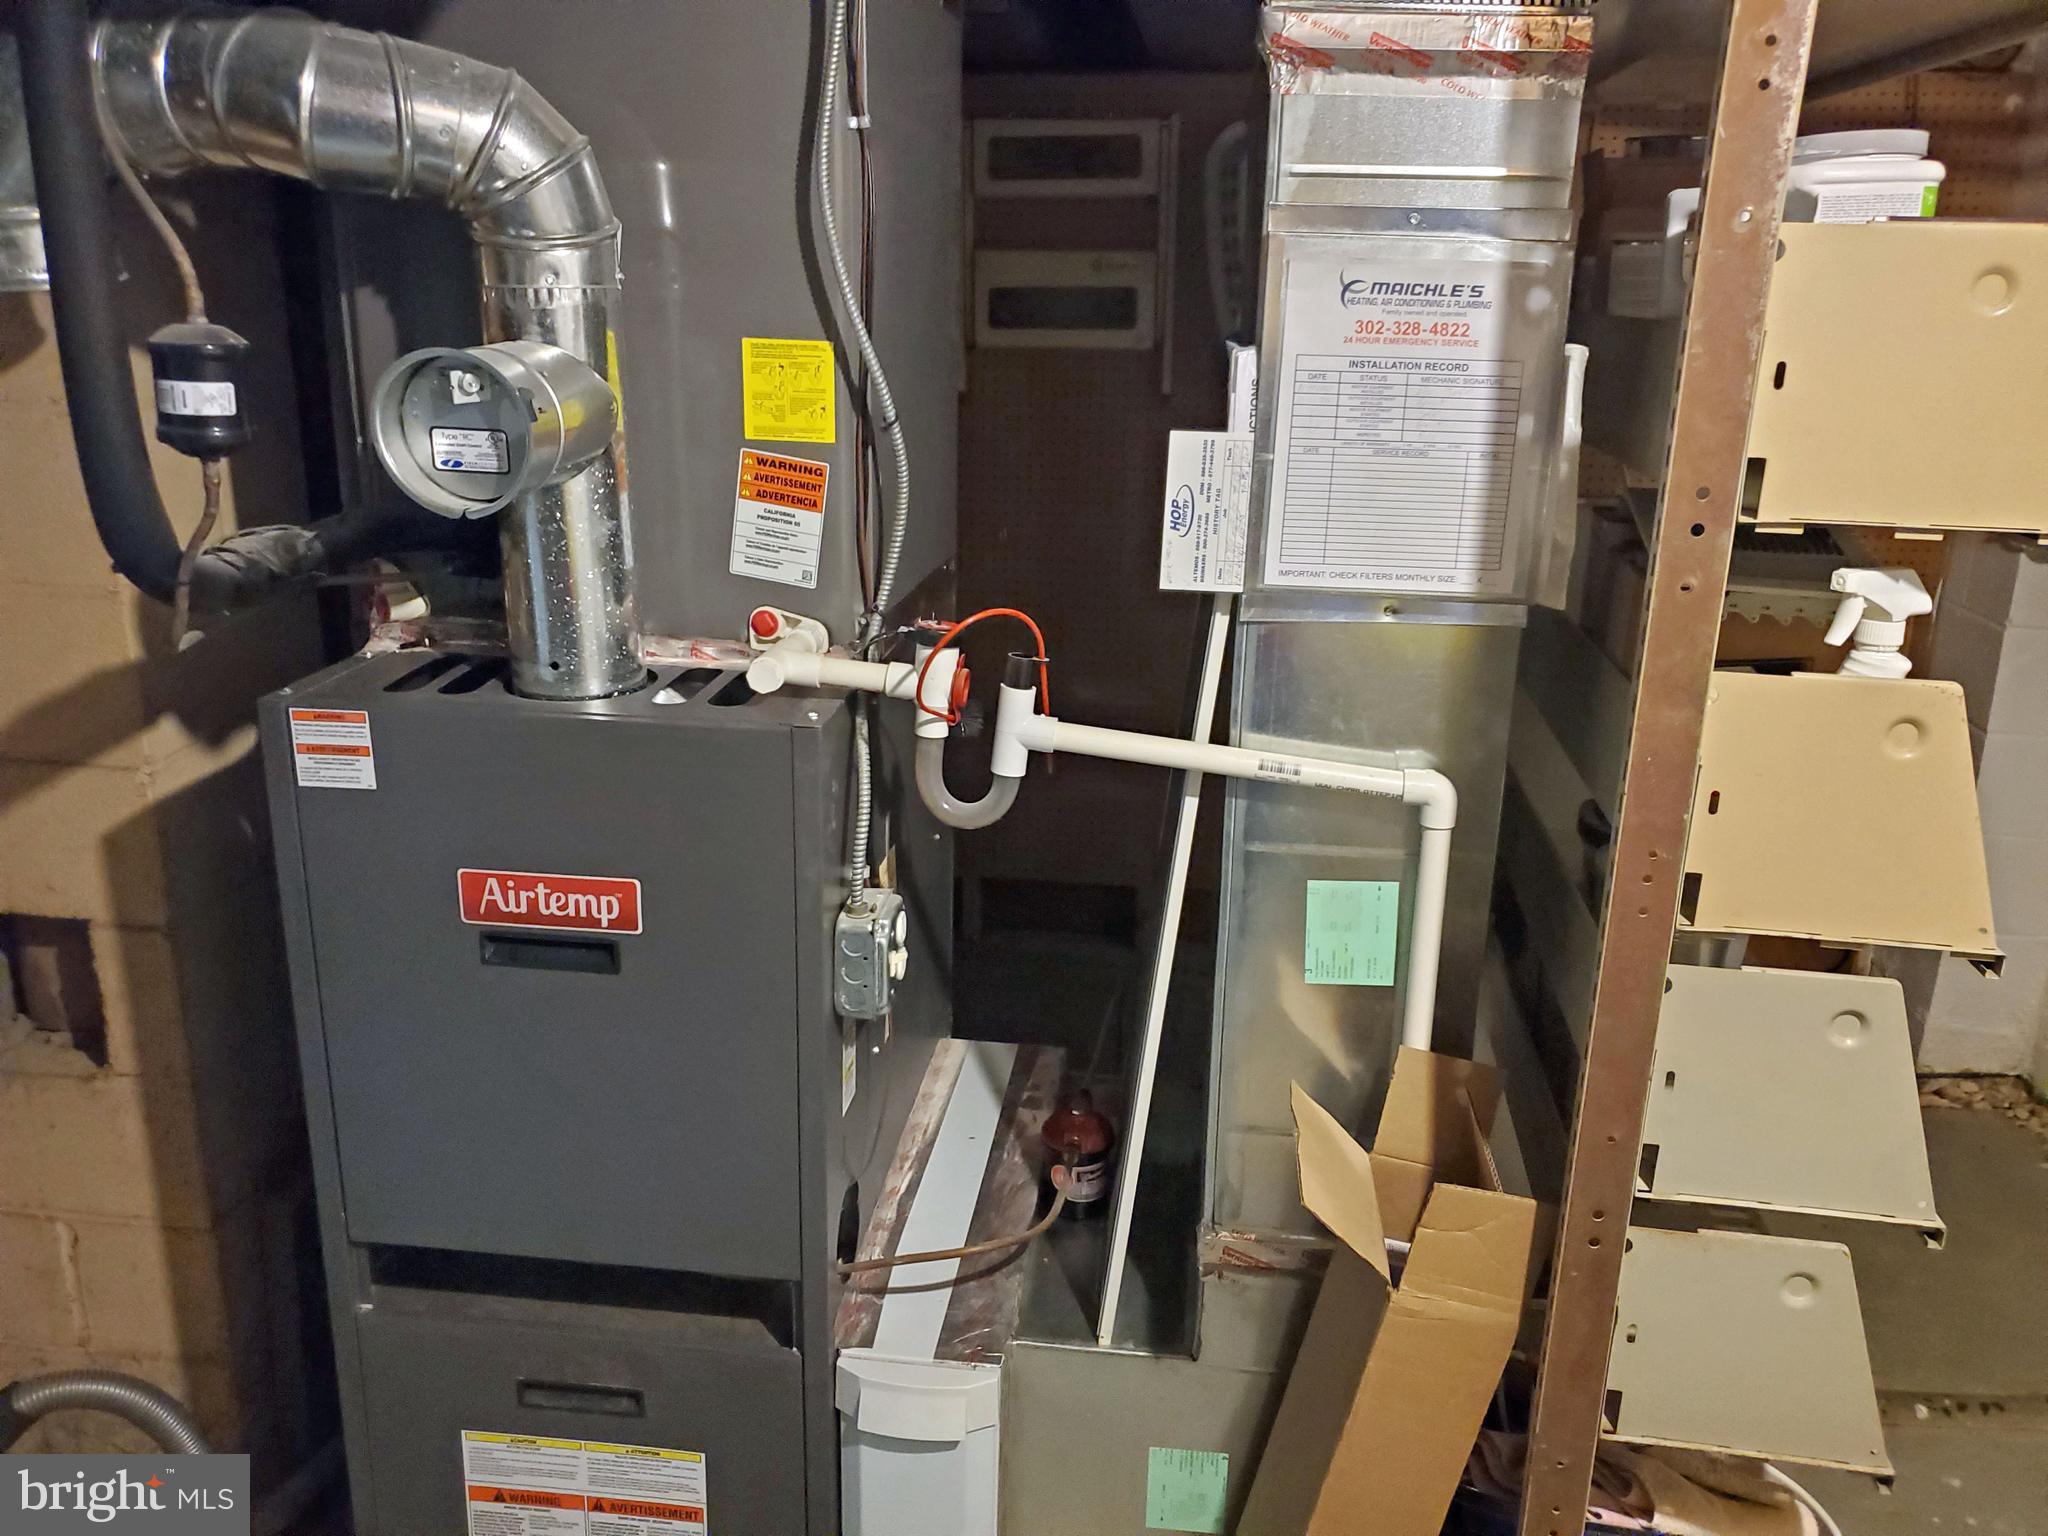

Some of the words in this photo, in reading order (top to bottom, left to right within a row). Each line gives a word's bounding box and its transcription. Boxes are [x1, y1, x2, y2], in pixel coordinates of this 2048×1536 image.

[1369, 282, 1486, 298] MAICHLE'S
[1394, 298, 1445, 309] CONDITIONING
[1446, 300, 1453, 308] &
[1453, 299, 1493, 310] PLUMBING
[1381, 308, 1402, 317] Family
[1354, 319, 1471, 338] 302-328-4822
[1343, 336, 1354, 344] 24
[1354, 336, 1381, 344] HOUR
[1383, 337, 1440, 346] EMERGENCY
[1441, 338, 1479, 348] SERVICE
[1348, 360, 1422, 371] INSTALLATION
[1424, 362, 1470, 373] RECORD
[1307, 373, 1328, 381] DATE
[1359, 374, 1389, 383] STATUS
[1420, 376, 1461, 385] MECHANIC
[441, 432, 458, 440] Type
[756, 457, 823, 477] WARNING
[753, 472, 823, 493] AVERTISSEMENT
[755, 489, 818, 508] ADVERTENCIA
[757, 514, 793, 526] PROPOSITION
[763, 508, 796, 519] CALIFORNIA
[1169, 498, 1183, 532] HOP
[1180, 498, 1189, 529] Energy
[1212, 505, 1220, 535] HISTORY
[1328, 571, 1358, 579] CHECK
[1359, 571, 1393, 581] FILTERS
[1394, 573, 1435, 582] MONTHLY
[479, 877, 621, 928] Airtemp
[508, 1493, 561, 1507] WARNING
[609, 1502, 699, 1521] AVERTISSEMENT
